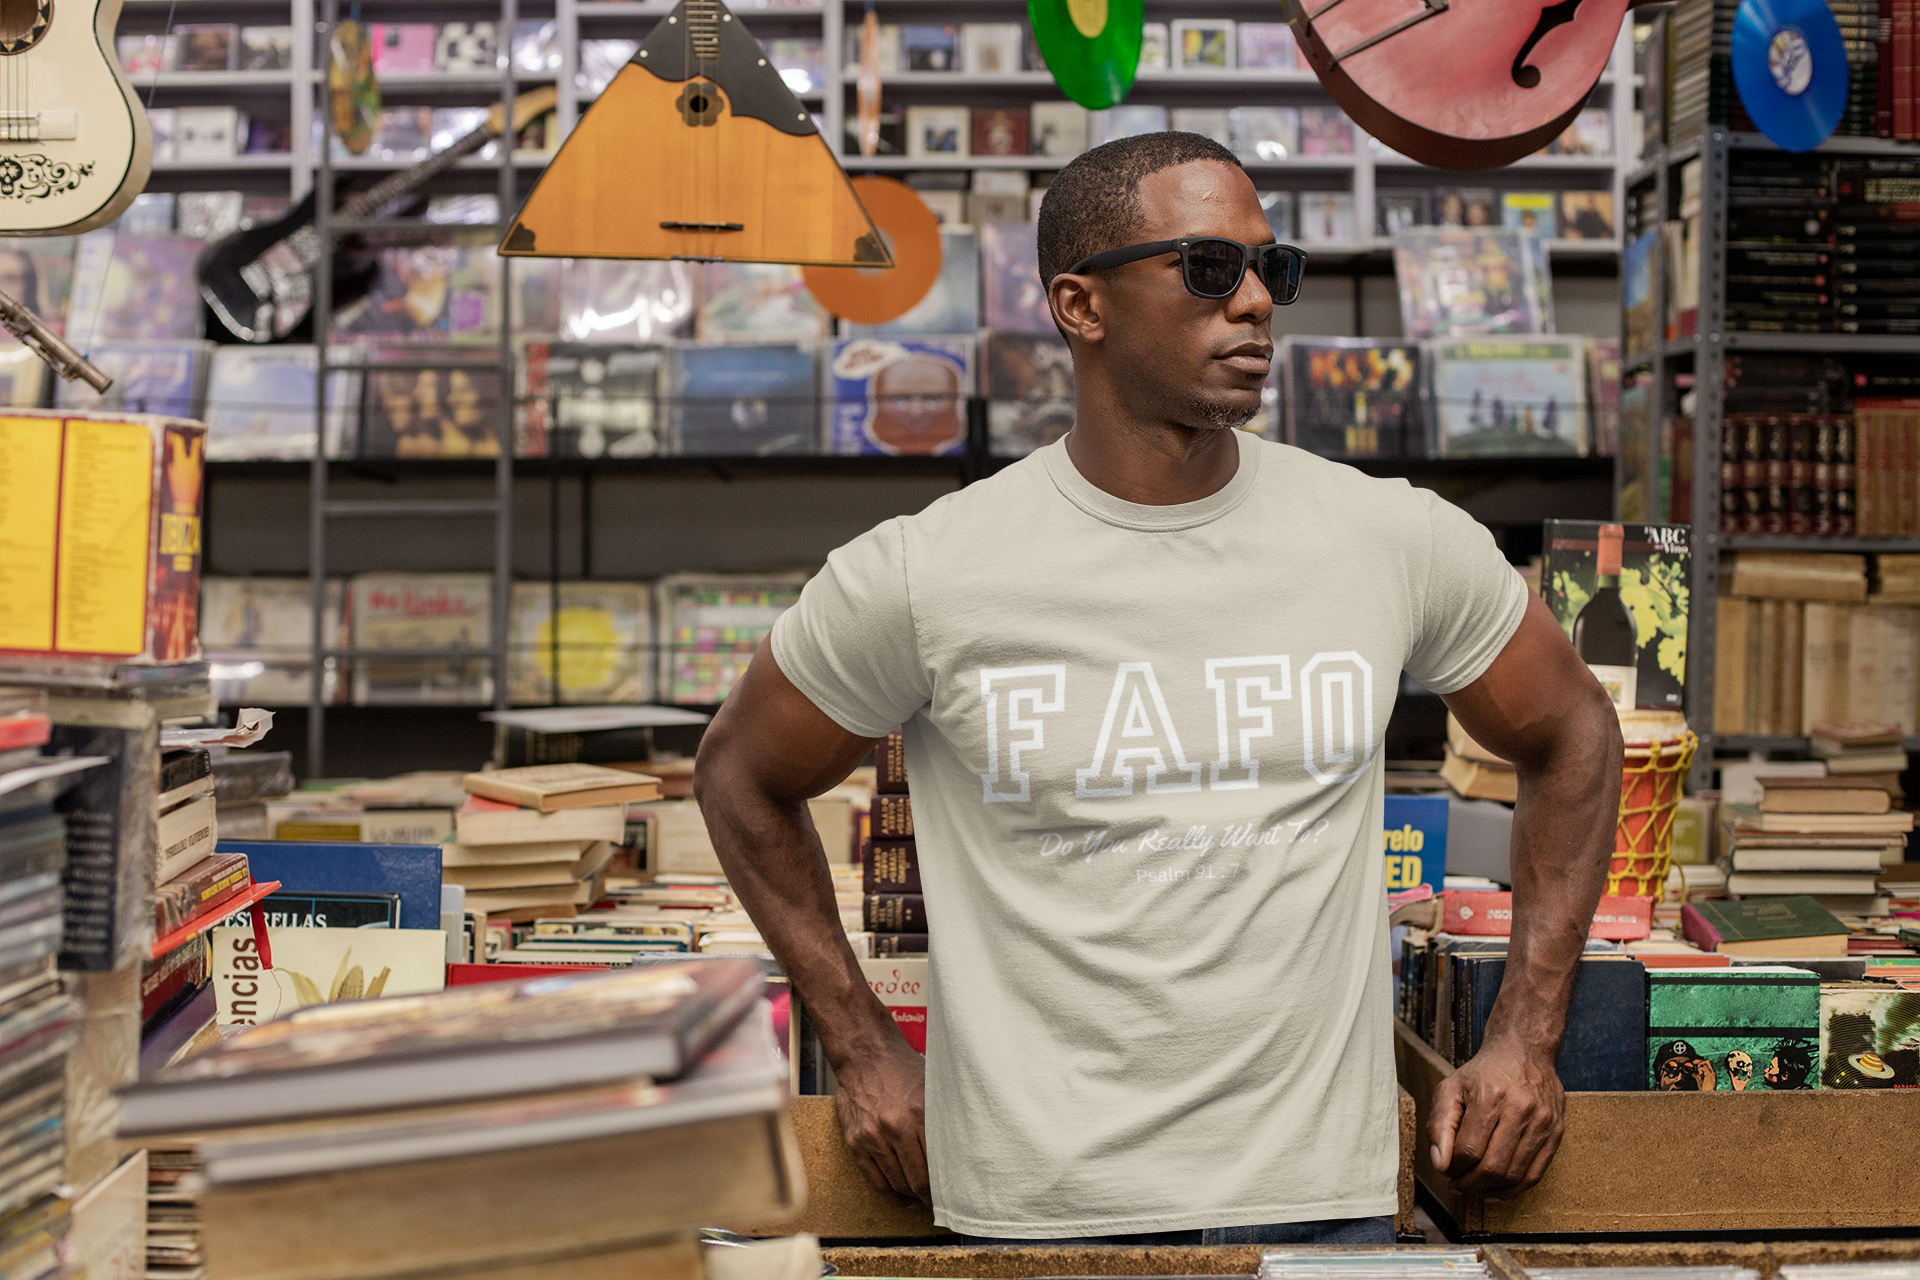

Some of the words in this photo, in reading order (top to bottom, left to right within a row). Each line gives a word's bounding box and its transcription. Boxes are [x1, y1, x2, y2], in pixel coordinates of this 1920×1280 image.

[1648, 527, 1686, 545] ABC
[1663, 542, 1689, 554] Vino
[979, 650, 1373, 803] FAFO
[1039, 832, 1074, 856] Do
[1082, 830, 1128, 863] You
[1138, 825, 1214, 858] Really
[1220, 823, 1283, 847] Want
[1287, 818, 1330, 844] To?
[1137, 866, 1190, 883] Psalm
